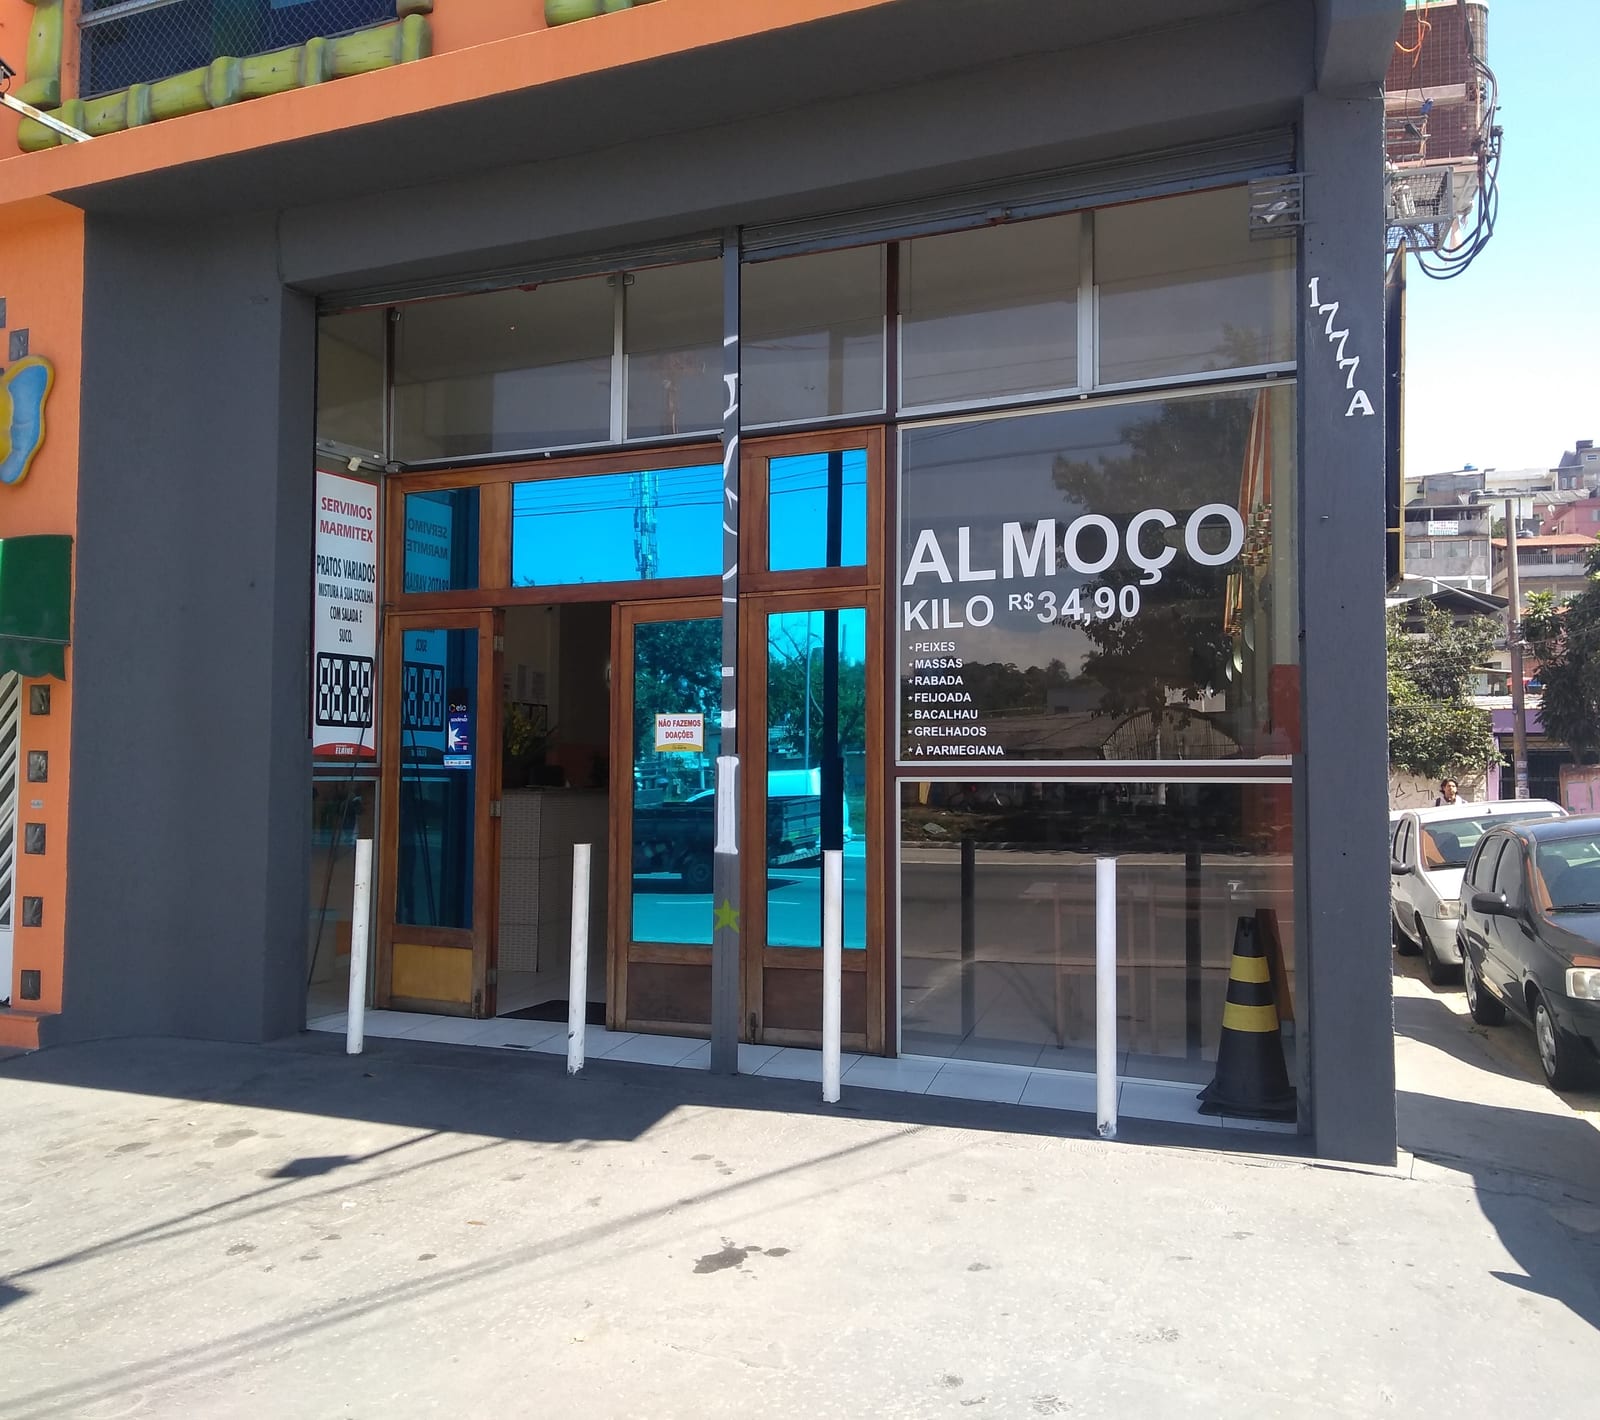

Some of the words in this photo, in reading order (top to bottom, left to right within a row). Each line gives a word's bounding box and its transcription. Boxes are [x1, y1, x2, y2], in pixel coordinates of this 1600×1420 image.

[321, 497, 372, 520] SERVIMOS
[319, 519, 374, 543] MARMITEX
[902, 503, 1245, 586] ALMOÇO
[317, 555, 342, 578] PRATOS
[343, 559, 375, 583] VARIADOS
[318, 582, 339, 599] MISTURA
[340, 585, 344, 600] A
[344, 586, 353, 601] SUA
[354, 588, 374, 604] ESCOLHA
[330, 606, 341, 620] COM
[342, 607, 359, 623] SALADA
[359, 609, 363, 623] E
[904, 595, 995, 632] KILO
[915, 641, 956, 653] PEIXES
[914, 658, 963, 670] MASSAS
[914, 675, 964, 687] RABADA
[914, 692, 972, 703] FEIJOADA
[914, 709, 979, 720] BACALHAU
[658, 719, 671, 727] NÃO
[673, 719, 701, 727] FAZEMOS
[665, 730, 694, 740] DOAÇÕES
[914, 726, 987, 738] GRELHADOS
[915, 743, 925, 756] À
[926, 744, 1005, 756] PARMEGIANA
